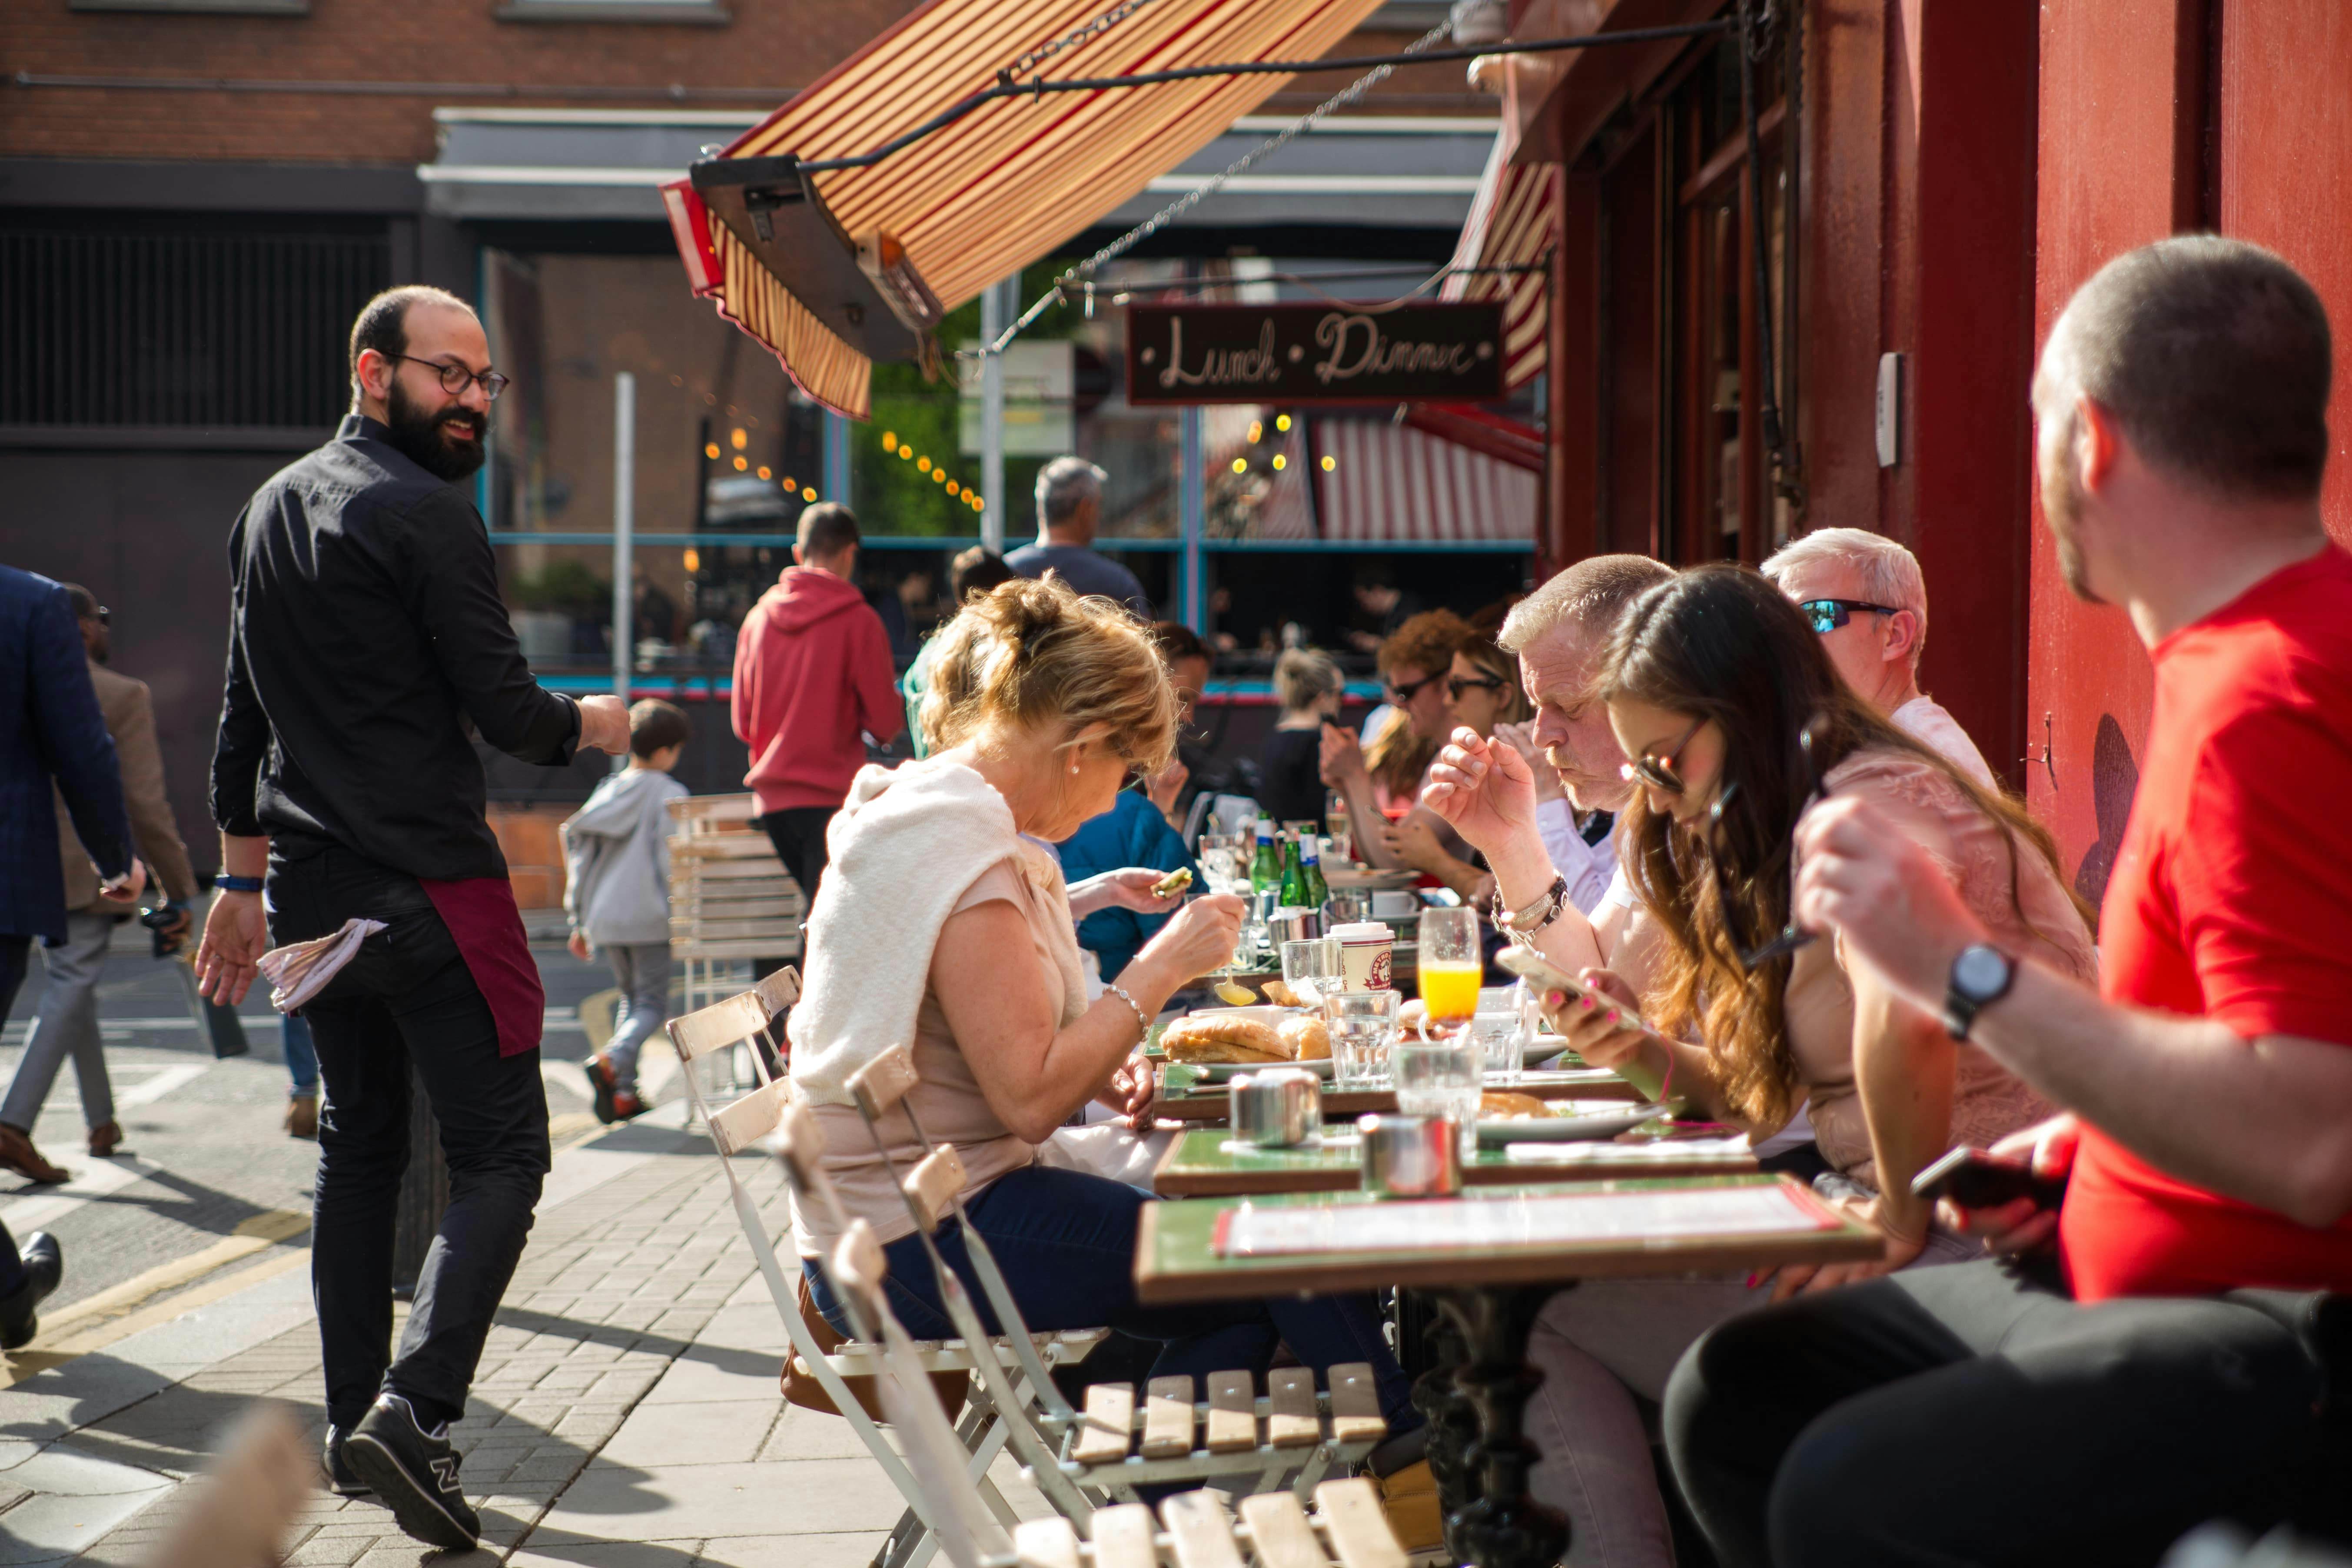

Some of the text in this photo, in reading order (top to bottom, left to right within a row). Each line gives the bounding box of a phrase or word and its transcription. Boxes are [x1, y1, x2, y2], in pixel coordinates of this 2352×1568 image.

[1160, 312, 1475, 388] Lunch Dinner
[430, 1457, 462, 1493] N
